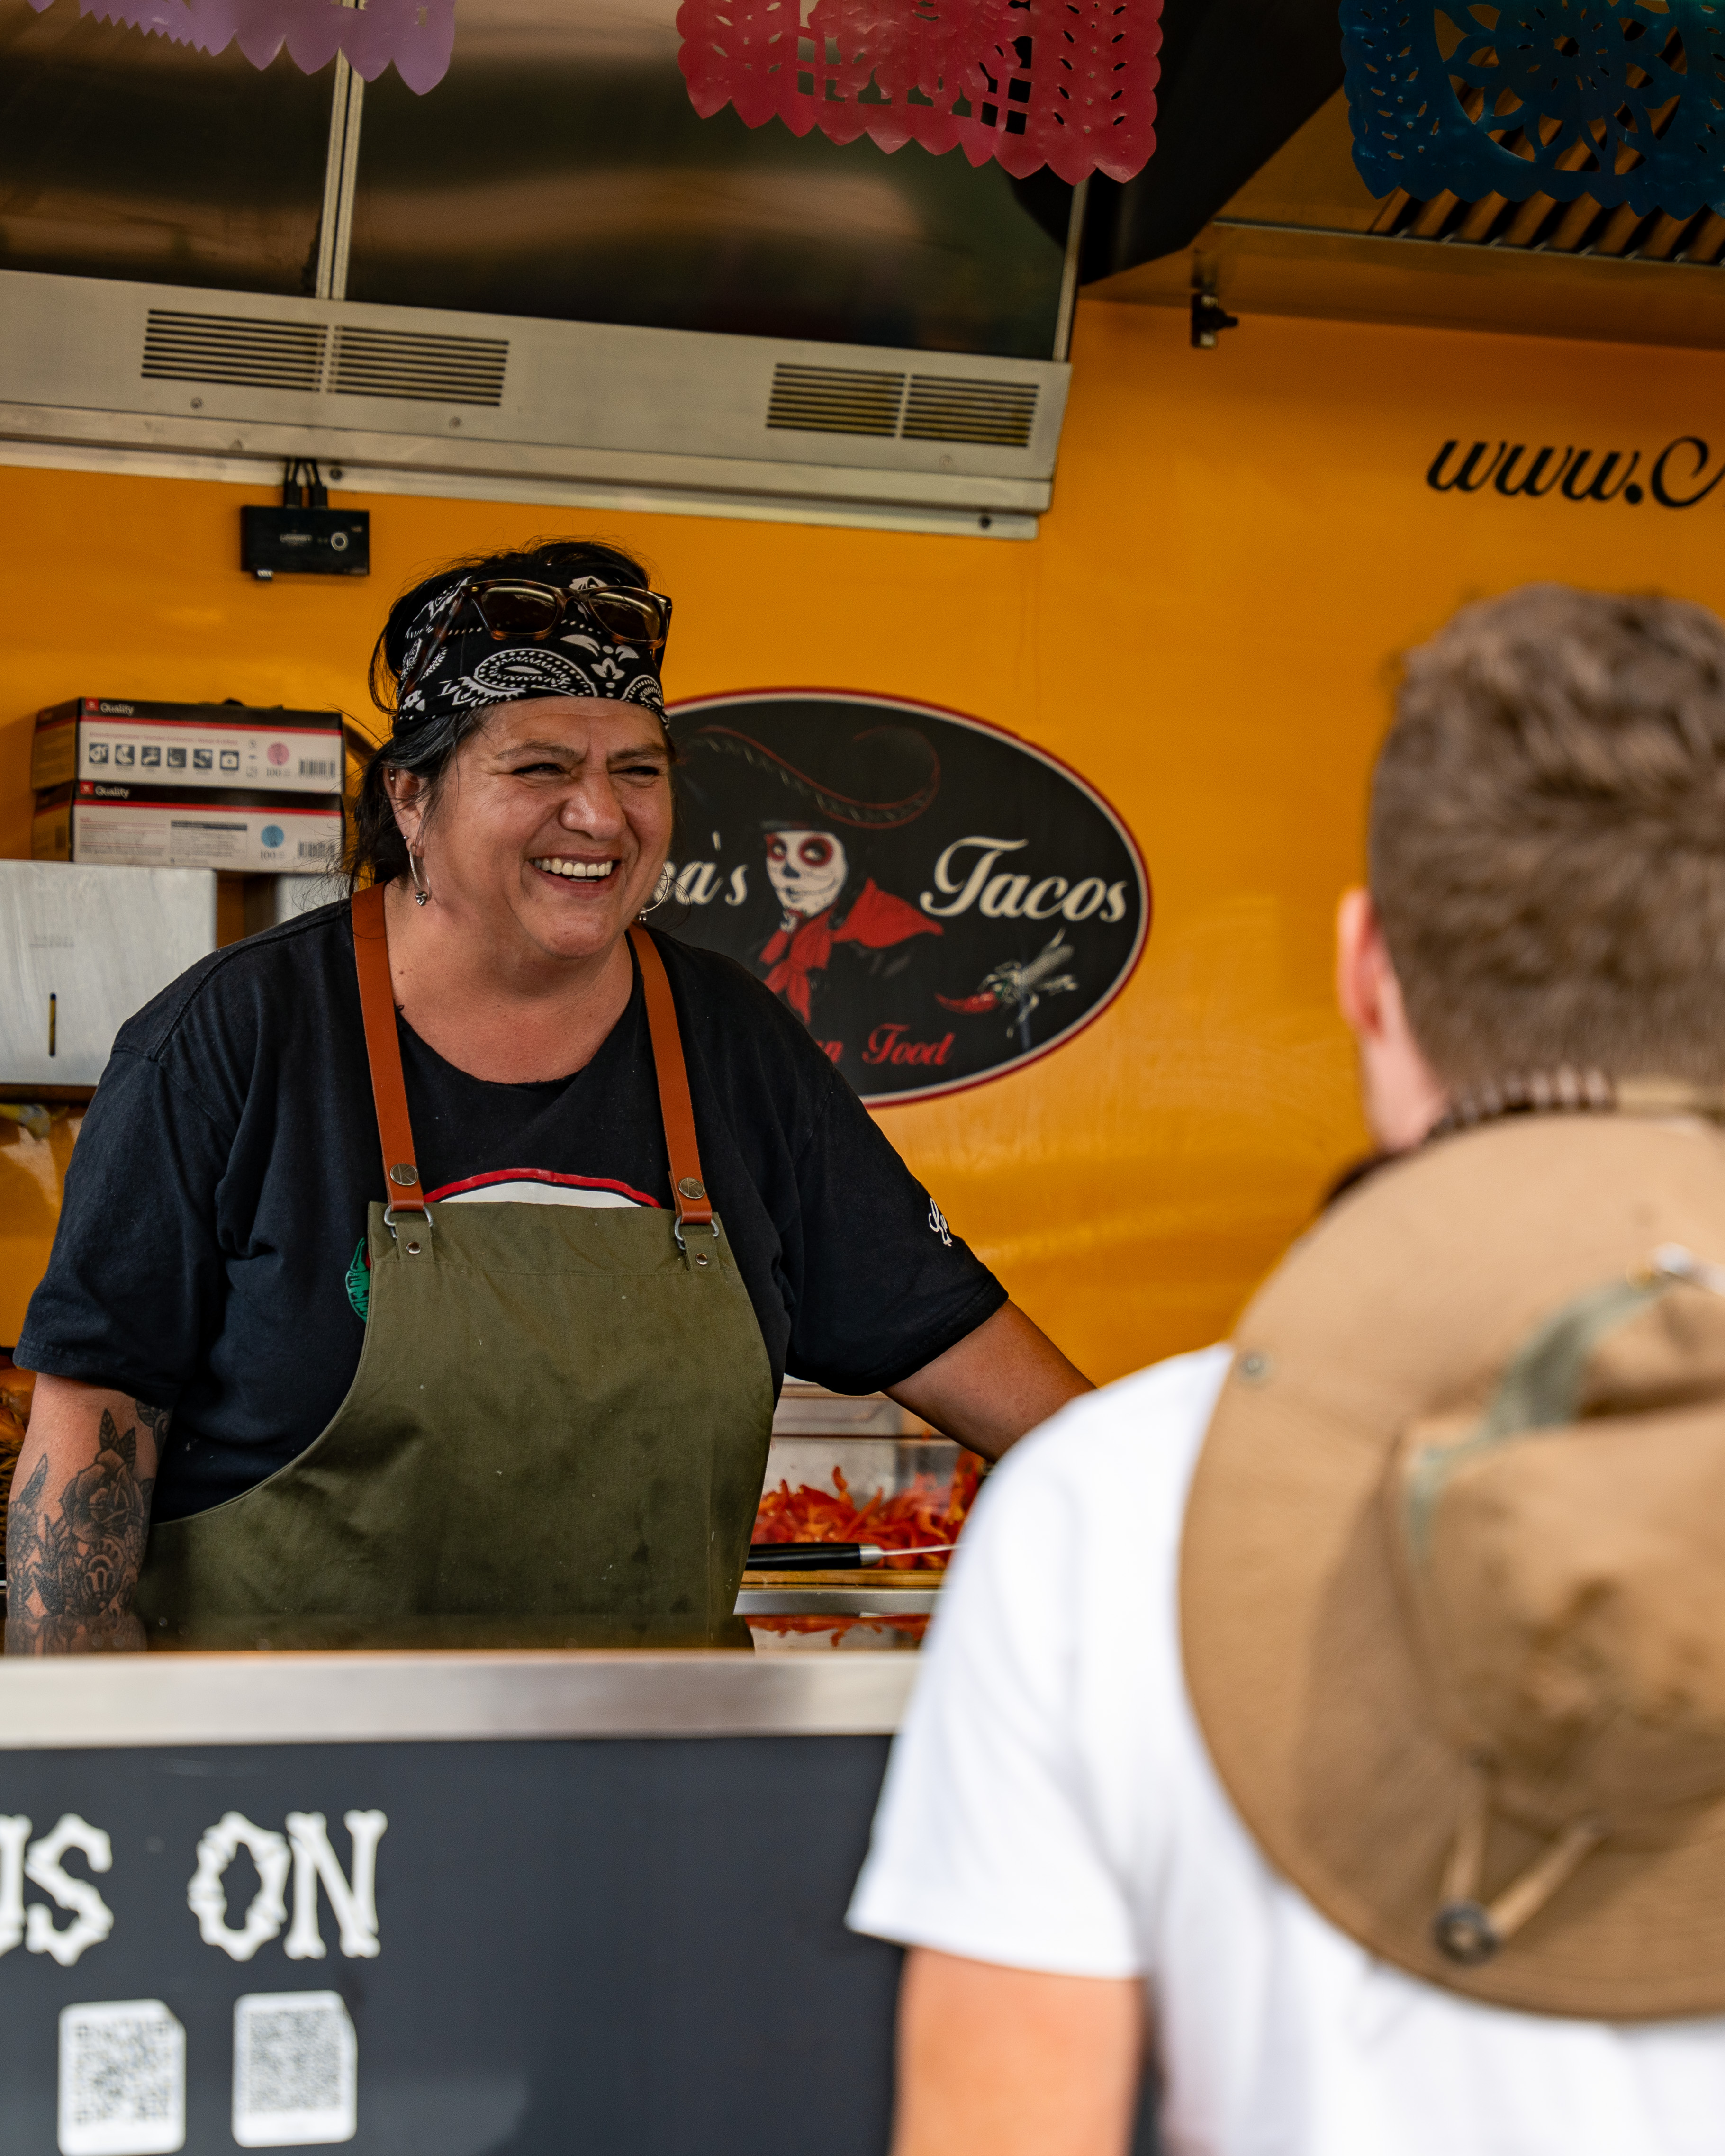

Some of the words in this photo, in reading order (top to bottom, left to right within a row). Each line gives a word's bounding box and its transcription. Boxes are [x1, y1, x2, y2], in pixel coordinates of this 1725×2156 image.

[100, 702, 135, 716] Quality
[95, 785, 130, 799] Quality
[920, 835, 1128, 924] Tacos
[861, 1022, 956, 1066] Food
[187, 1809, 389, 1962] ON
